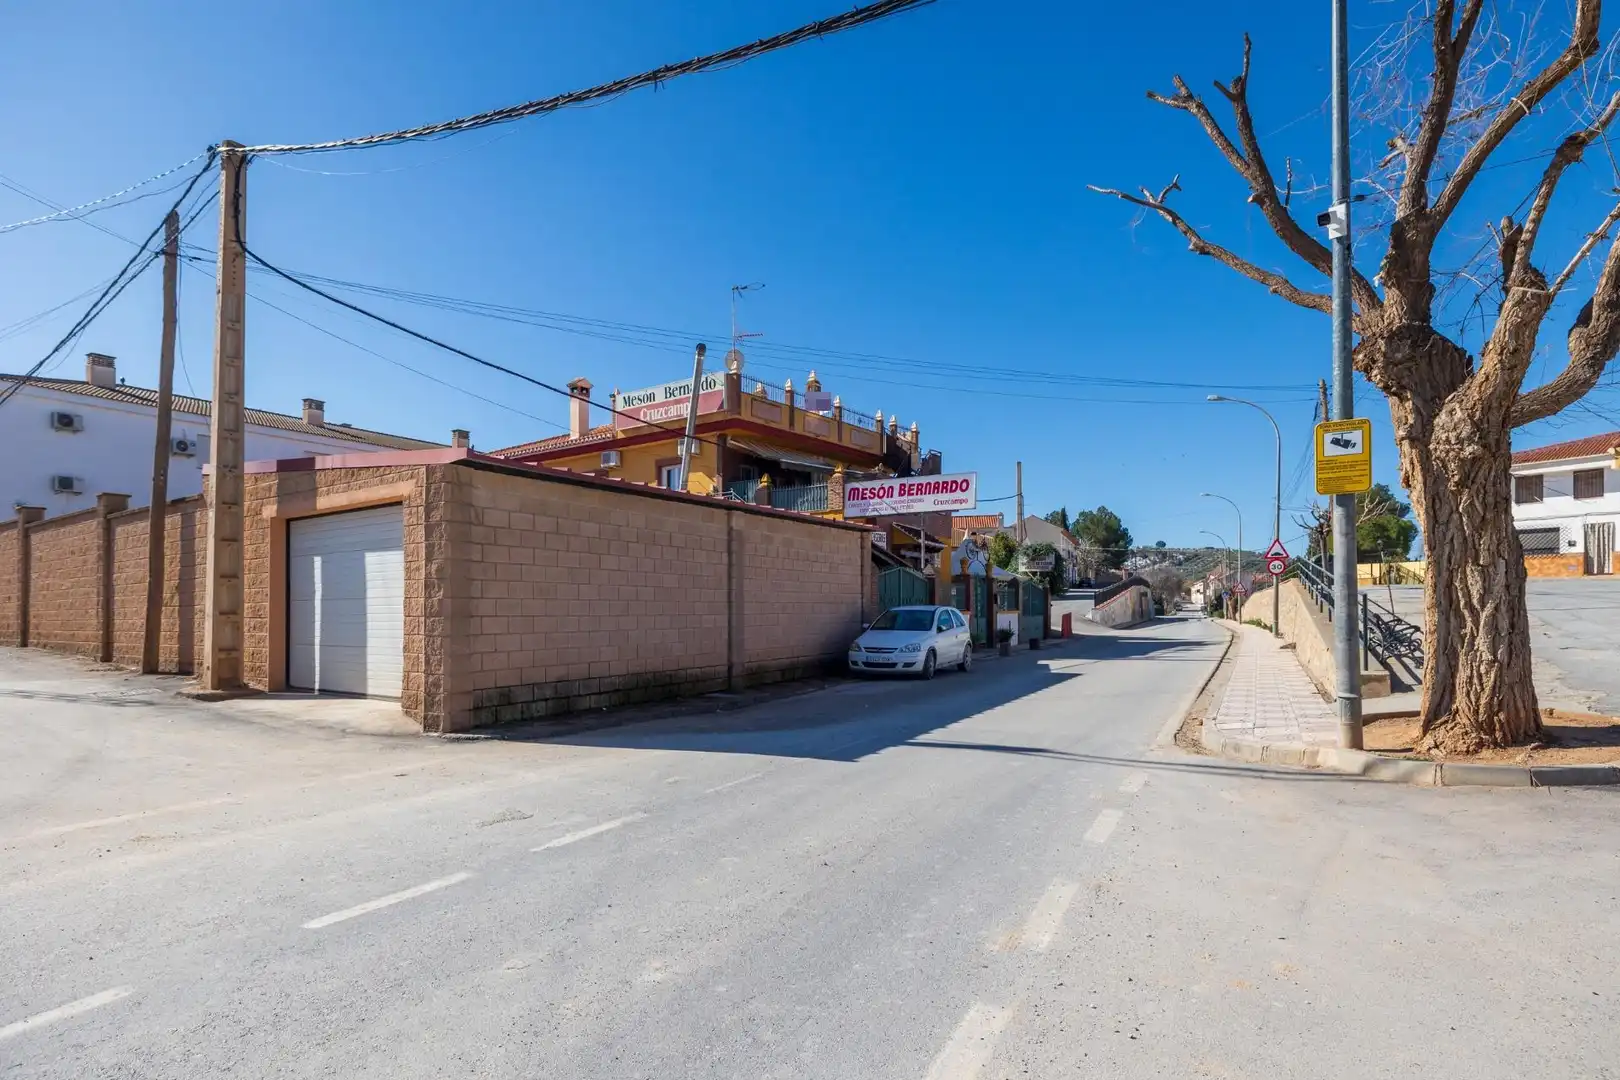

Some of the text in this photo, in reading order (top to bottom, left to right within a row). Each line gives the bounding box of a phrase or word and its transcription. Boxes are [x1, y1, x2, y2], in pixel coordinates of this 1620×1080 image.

[622, 376, 716, 408] Mesón Berndo
[640, 402, 691, 421] Cruzcamp
[848, 479, 970, 501] MESÓN BERNARDO
[933, 498, 968, 506] Cruzcampo
